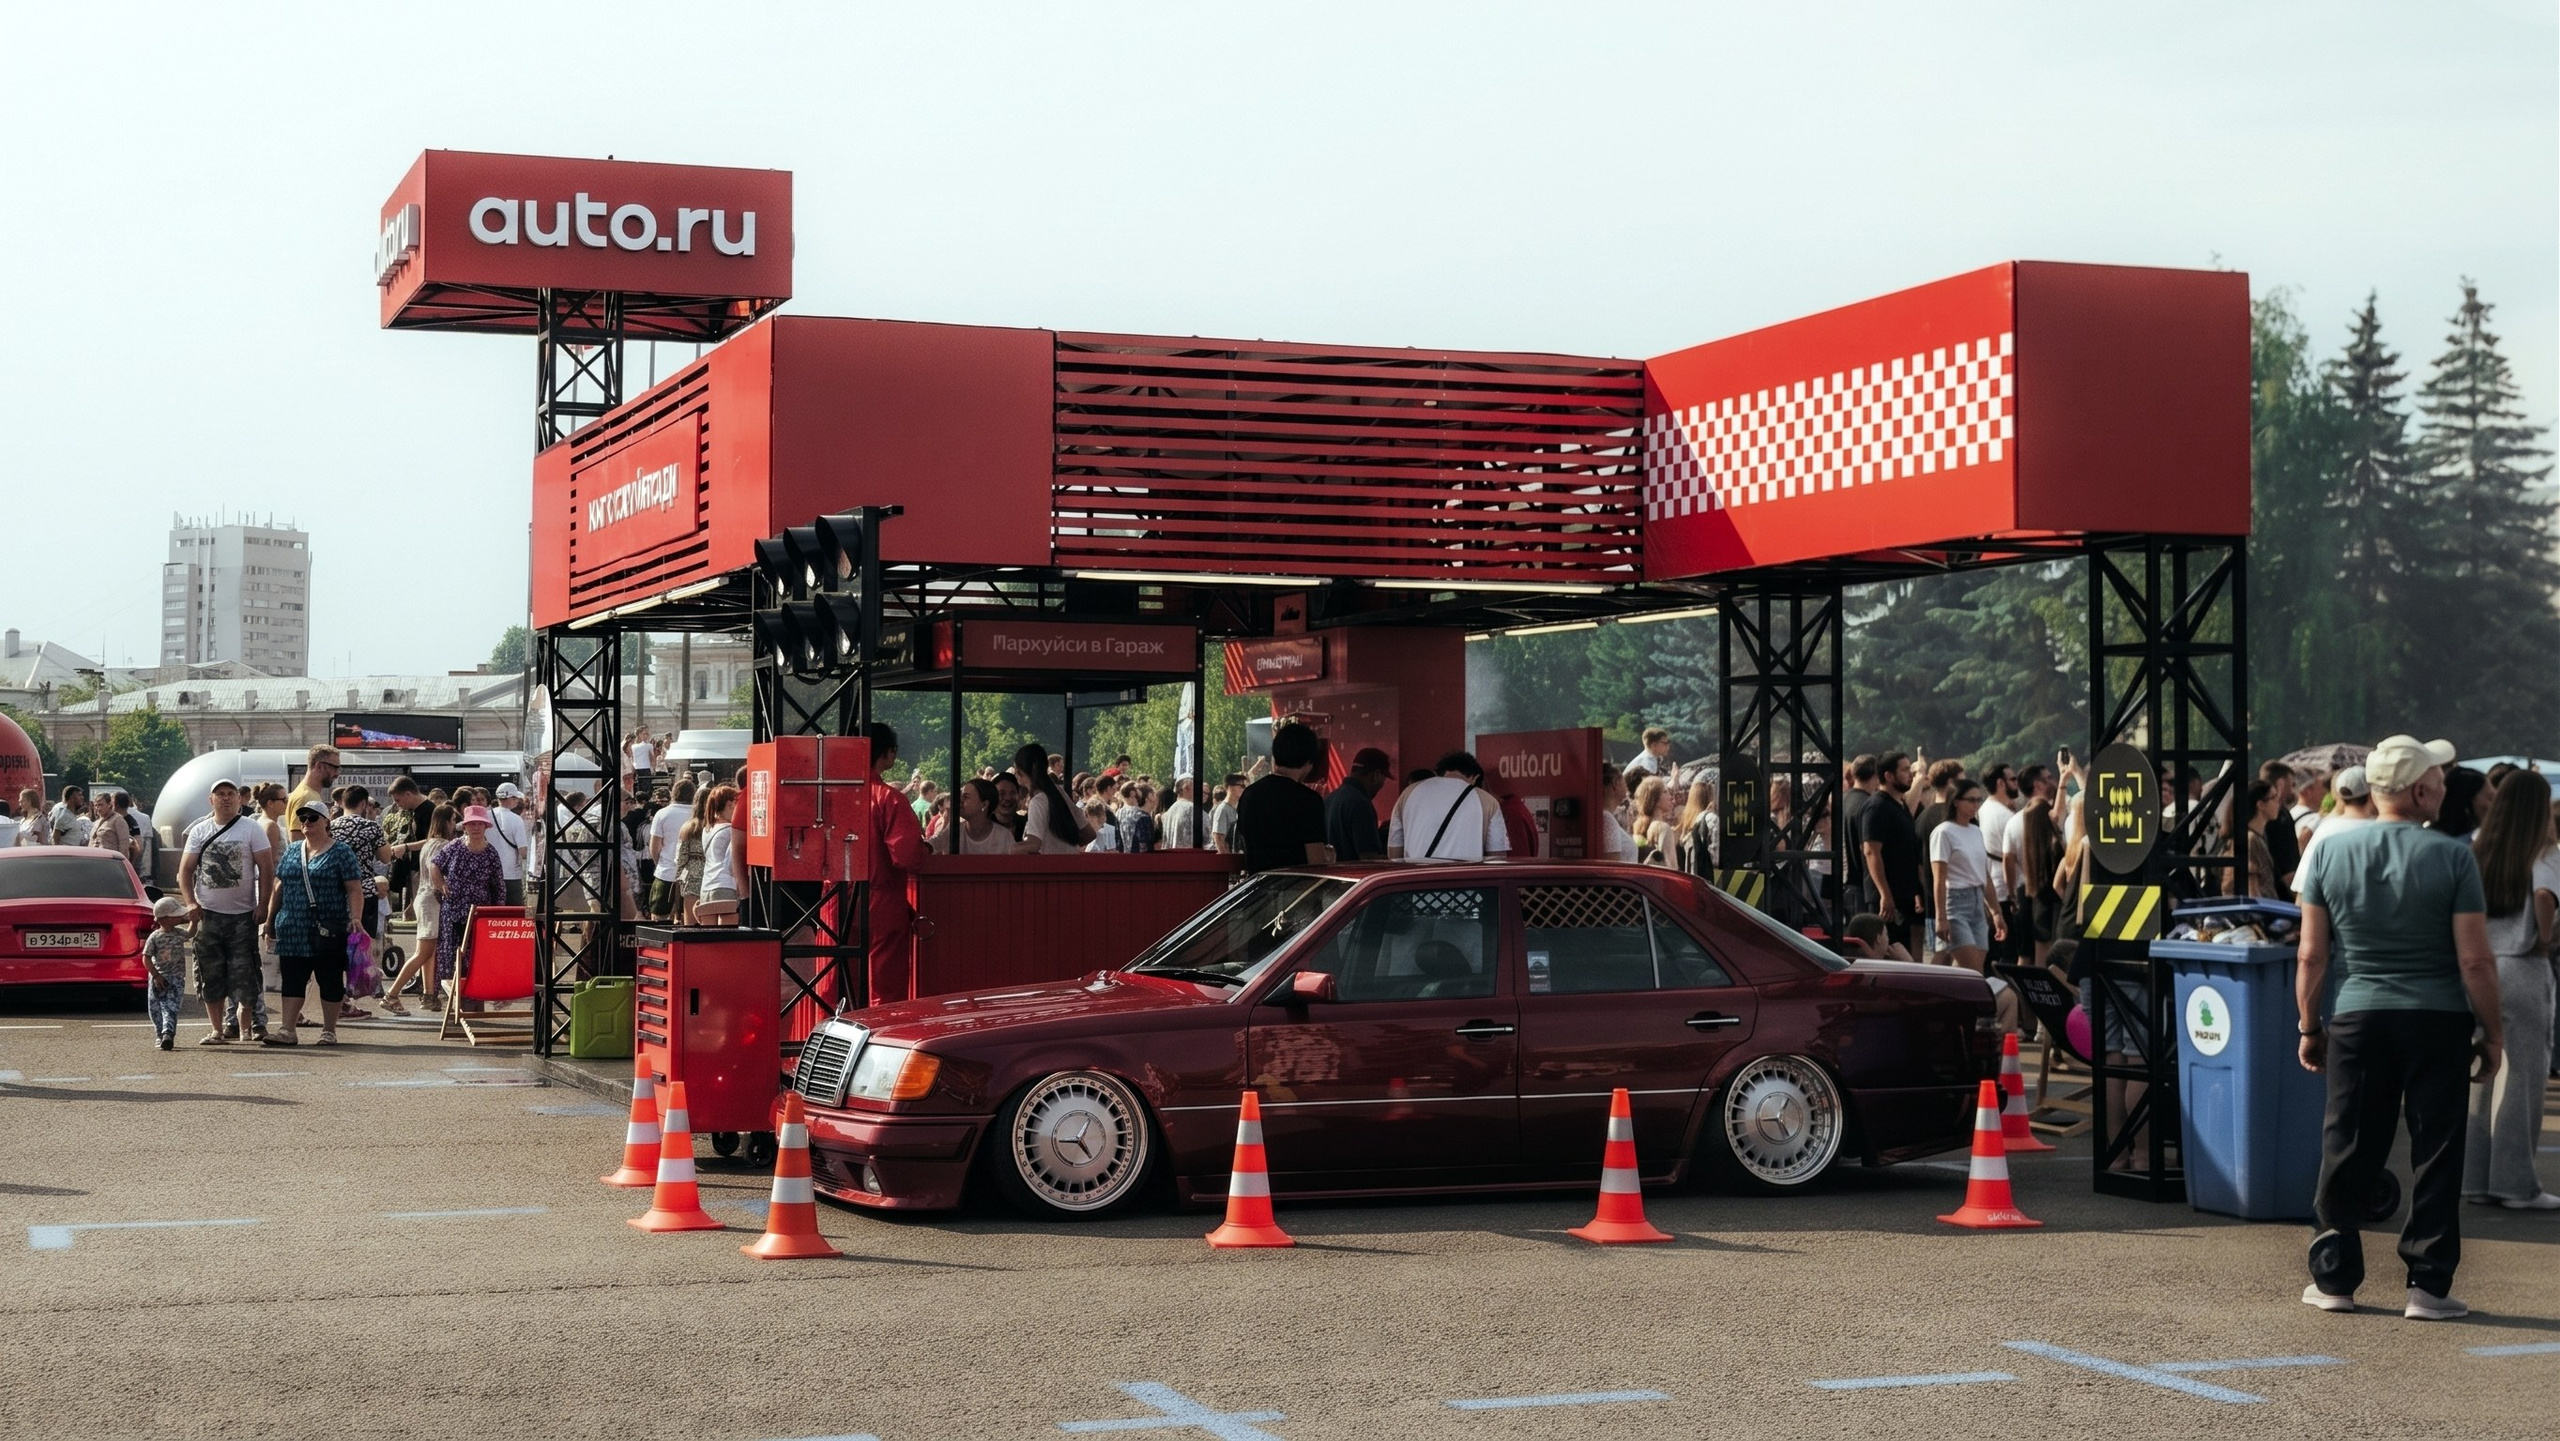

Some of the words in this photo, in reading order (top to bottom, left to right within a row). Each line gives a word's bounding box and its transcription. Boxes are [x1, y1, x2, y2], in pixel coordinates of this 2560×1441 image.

[469, 192, 756, 257] auto.ru
[1091, 640, 1102, 653] в
[1106, 637, 1165, 658] Гараж
[1498, 749, 1562, 779] auto.ru
